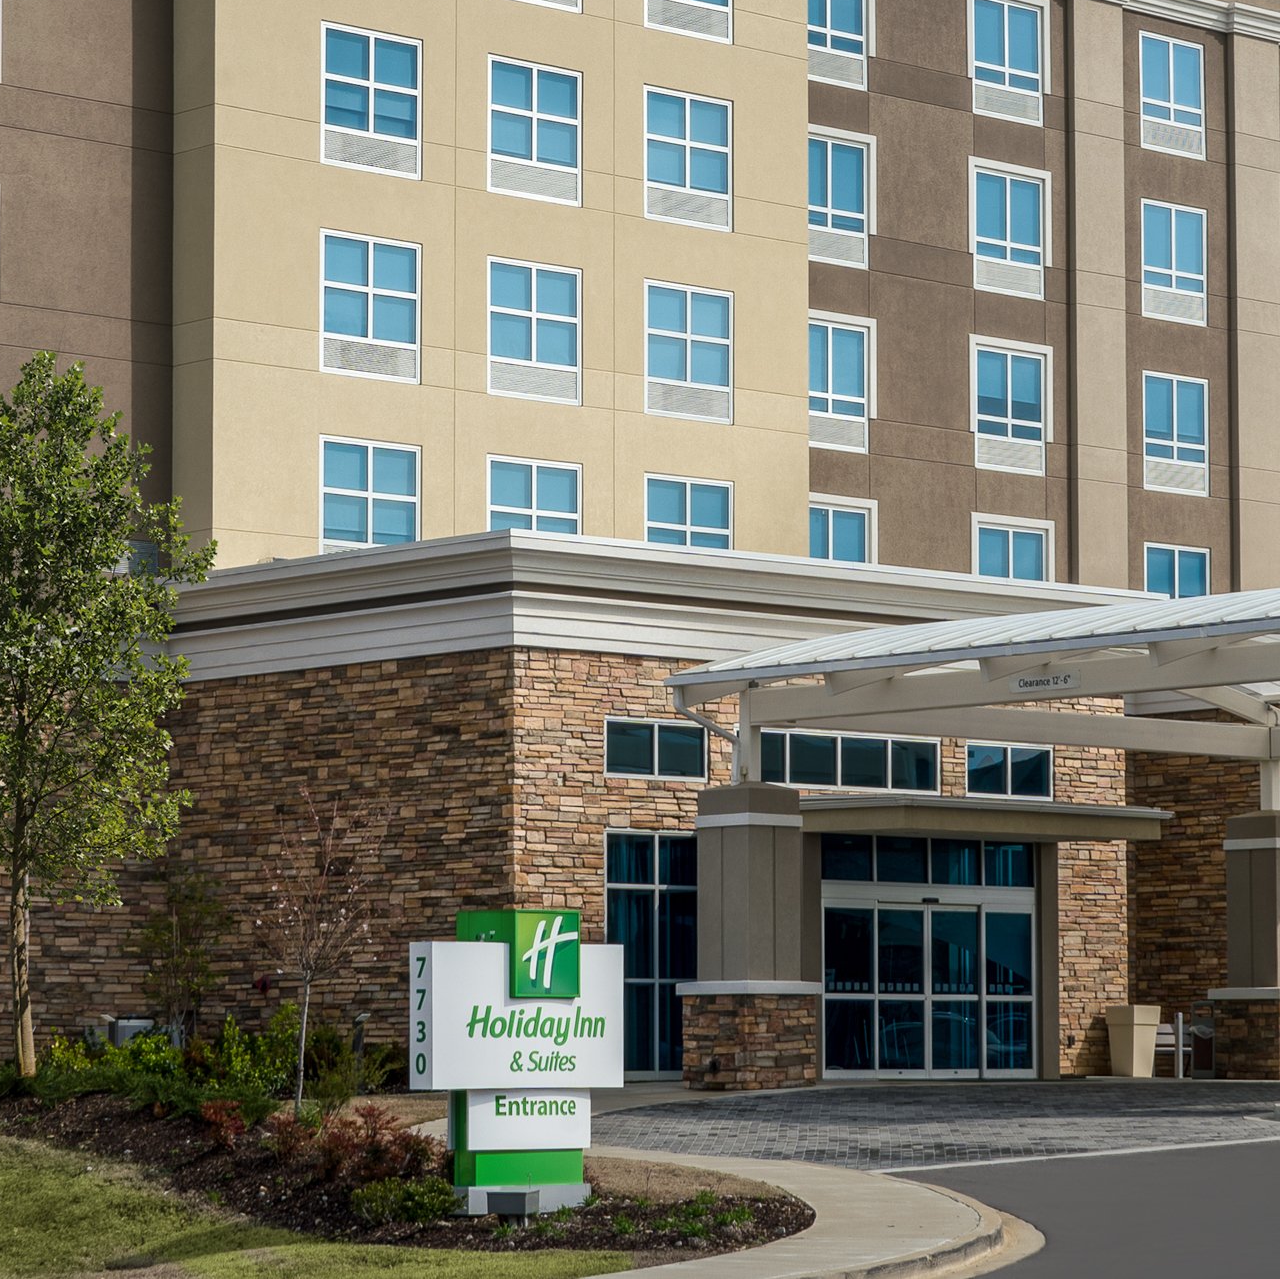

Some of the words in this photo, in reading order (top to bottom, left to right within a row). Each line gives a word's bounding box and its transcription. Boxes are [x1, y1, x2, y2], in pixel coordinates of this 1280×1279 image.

[1018, 677, 1051, 689] Clearance
[466, 1005, 571, 1046] Holiday
[573, 1005, 606, 1038] Inn
[509, 1050, 523, 1072] &
[527, 1050, 577, 1072] Suites
[495, 1095, 576, 1116] Entrance
